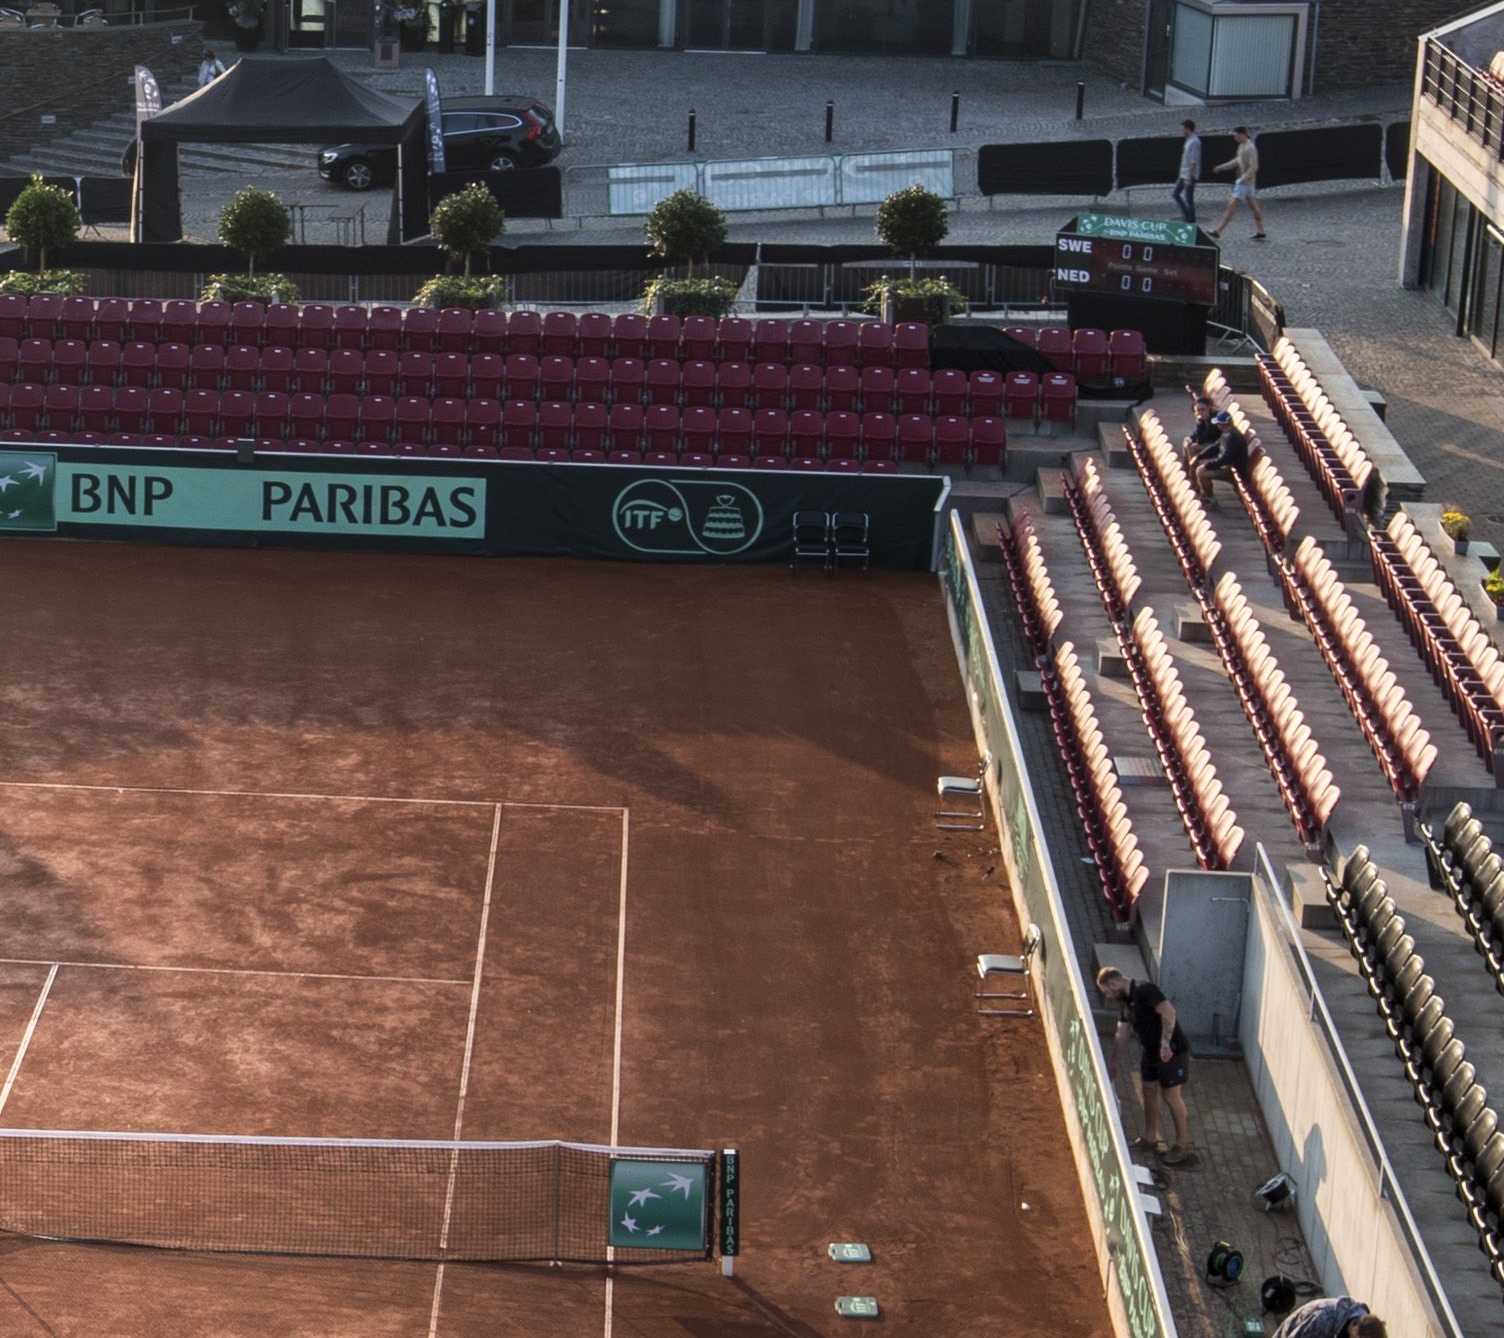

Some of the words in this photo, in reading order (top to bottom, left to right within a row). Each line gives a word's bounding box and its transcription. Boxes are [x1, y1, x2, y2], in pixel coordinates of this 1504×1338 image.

[1104, 217, 1138, 230] DAVIS
[1142, 221, 1167, 231] CUP
[1058, 238, 1092, 253] SWE
[1057, 268, 1090, 283] NED
[71, 473, 173, 516] BNP
[262, 481, 476, 529] PARIBAS
[624, 510, 664, 530] ITF
[725, 1156, 736, 1184] BNP
[725, 1189, 736, 1254] PARIBAS
